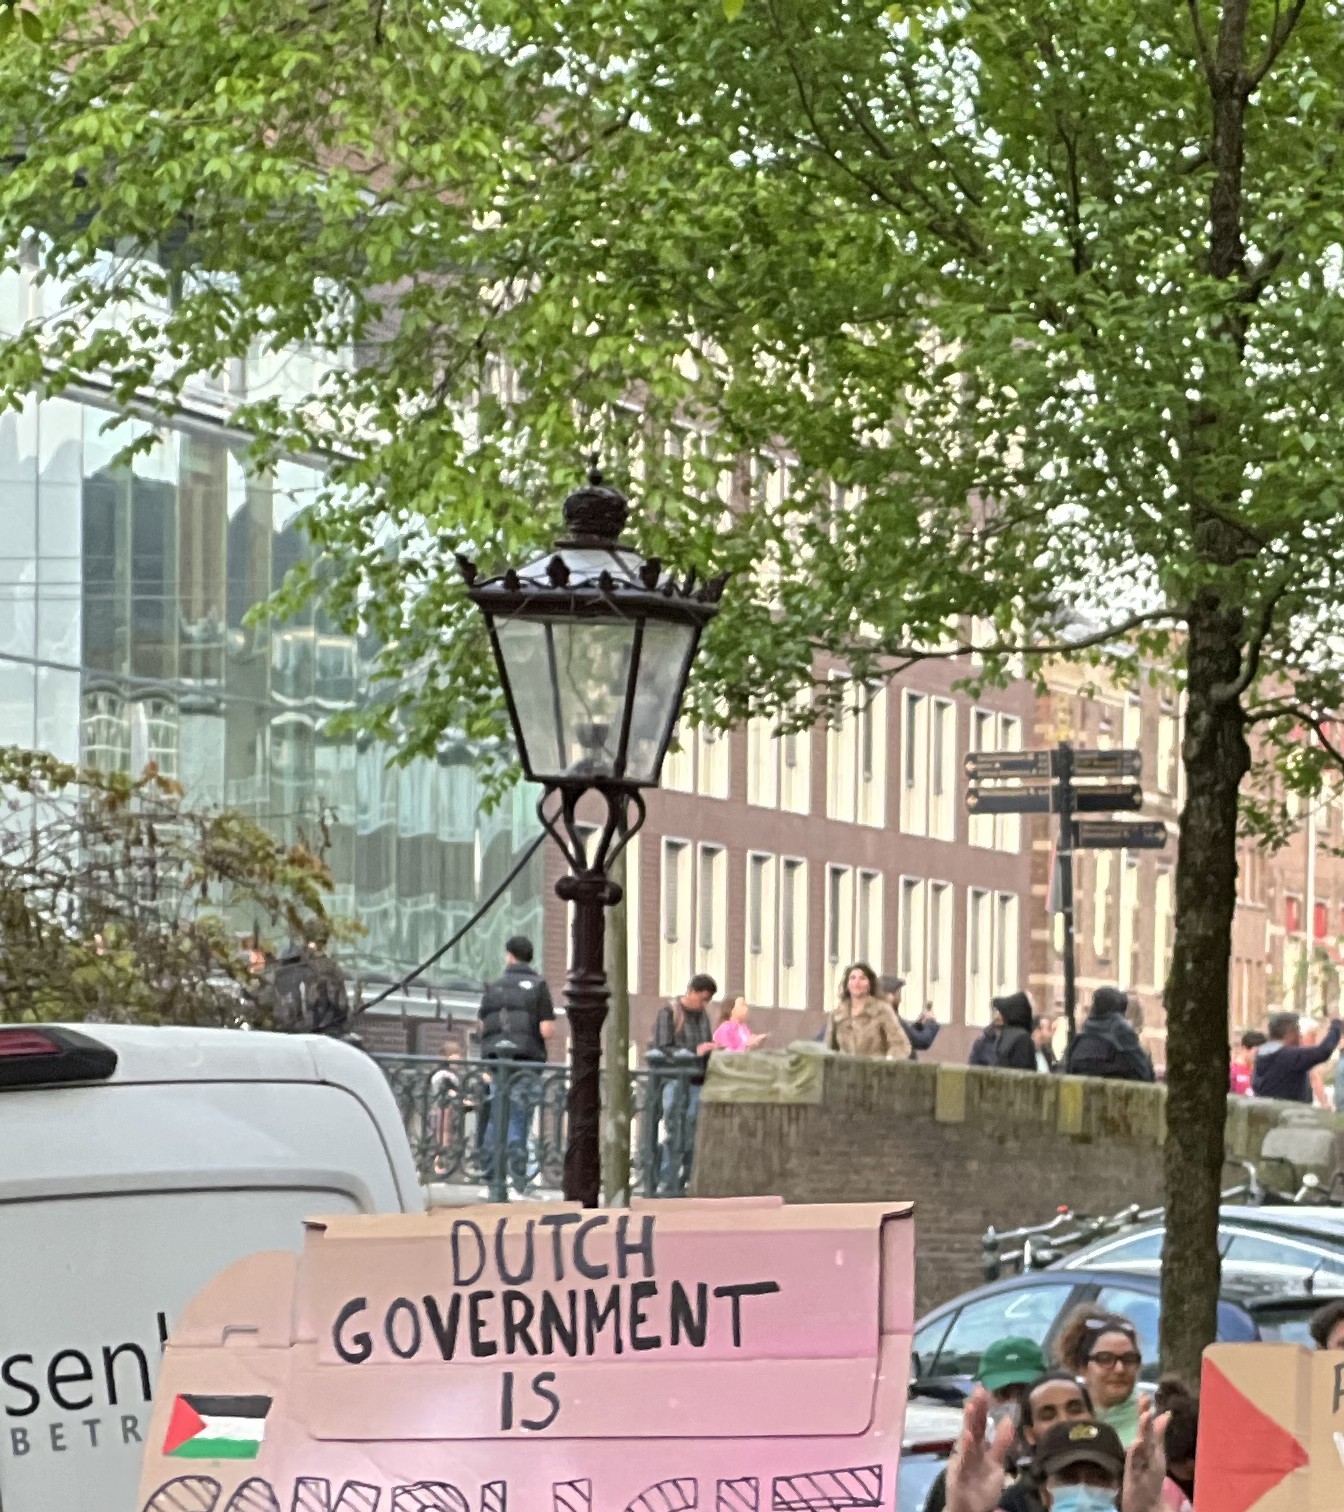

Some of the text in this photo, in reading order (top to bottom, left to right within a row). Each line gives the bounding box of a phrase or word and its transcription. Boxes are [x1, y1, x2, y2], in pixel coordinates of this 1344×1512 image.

[450, 1212, 656, 1287] DUTCH
[332, 1279, 782, 1365] GOVERNMENT
[500, 1371, 560, 1433] IS
